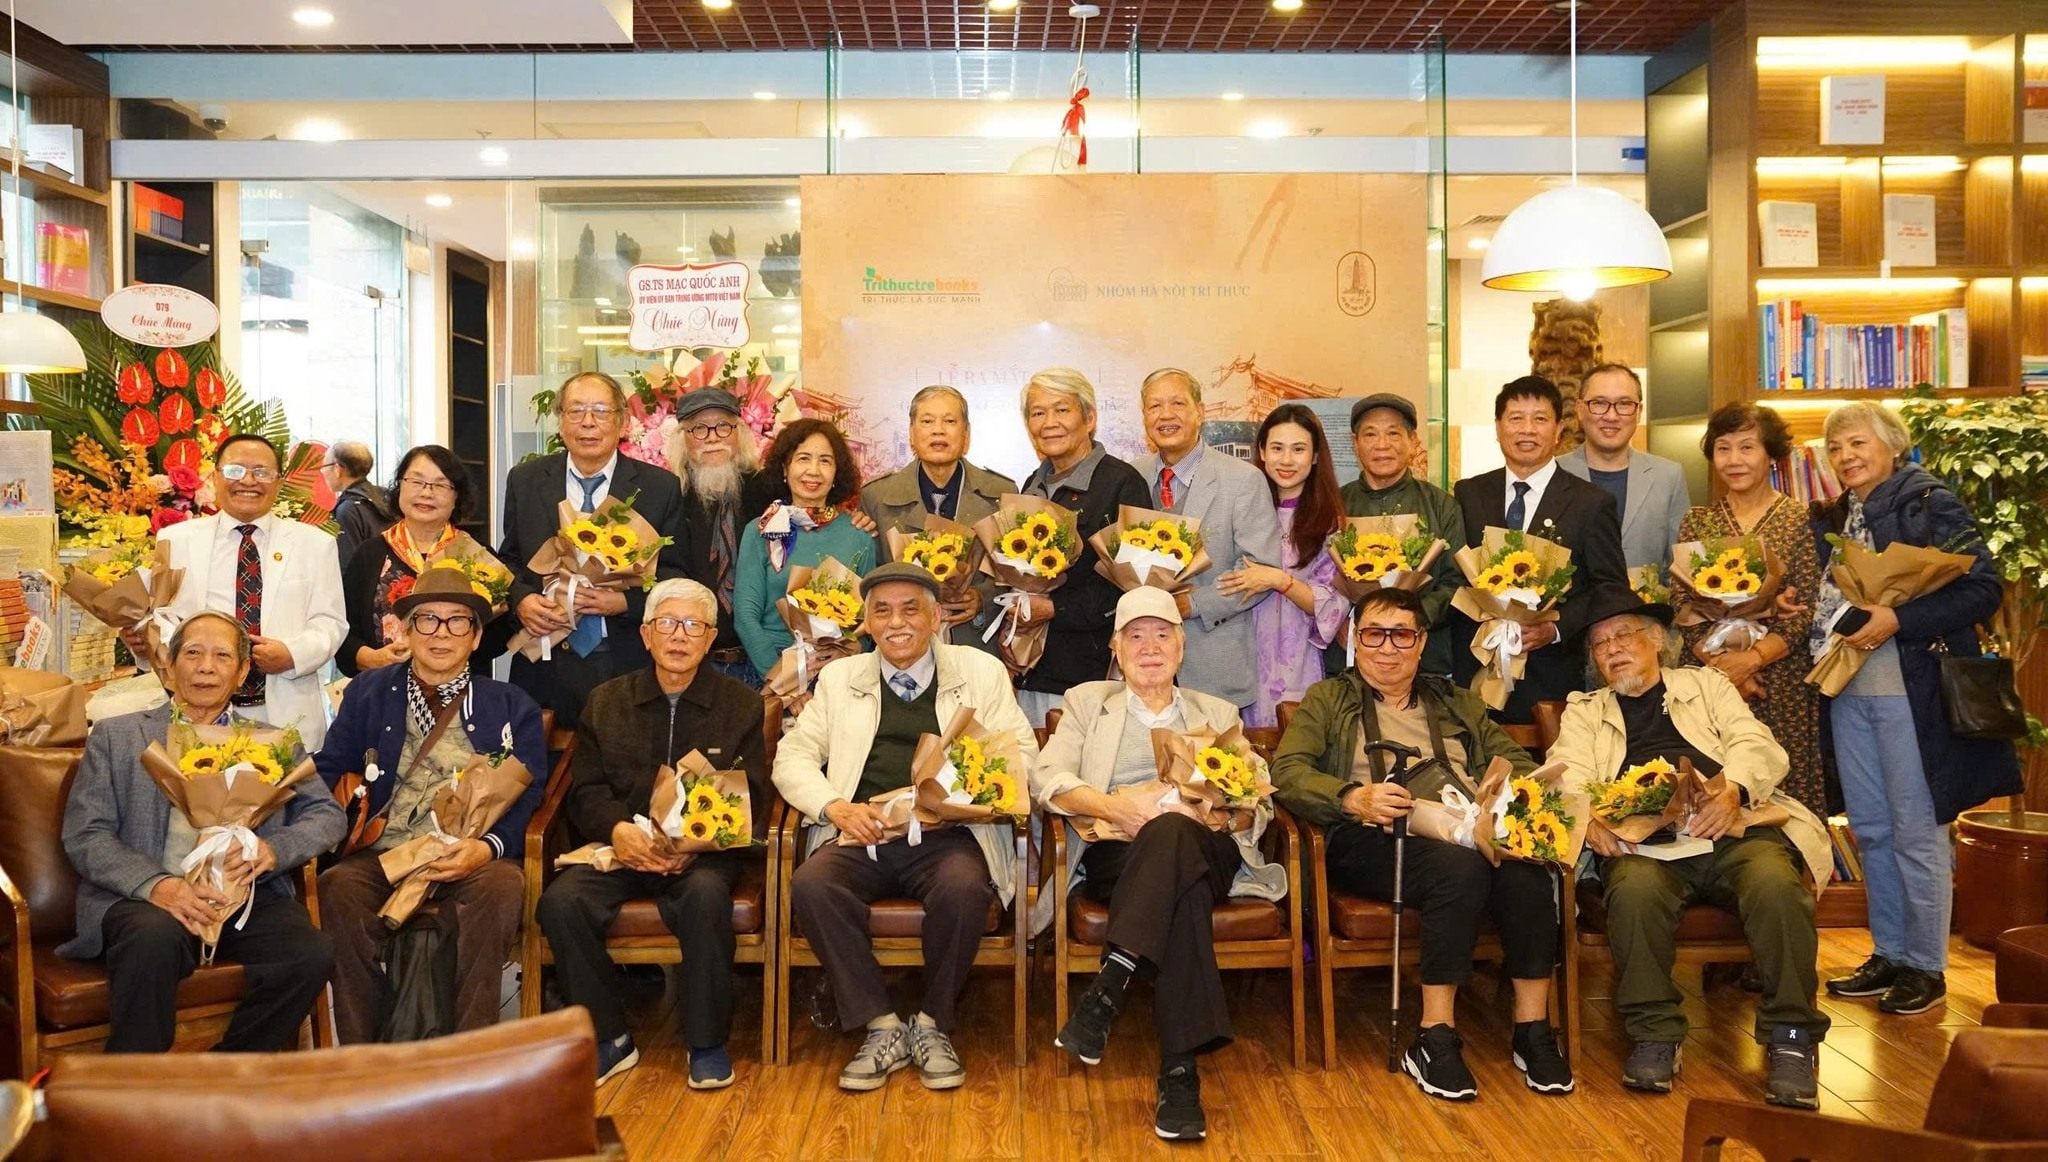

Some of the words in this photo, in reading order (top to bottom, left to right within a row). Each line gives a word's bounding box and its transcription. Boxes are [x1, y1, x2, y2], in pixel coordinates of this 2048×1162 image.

[639, 278, 664, 291] GS.TS
[666, 278, 688, 293] MẠC
[689, 271, 717, 289] QUỐC
[719, 276, 740, 288] ANH
